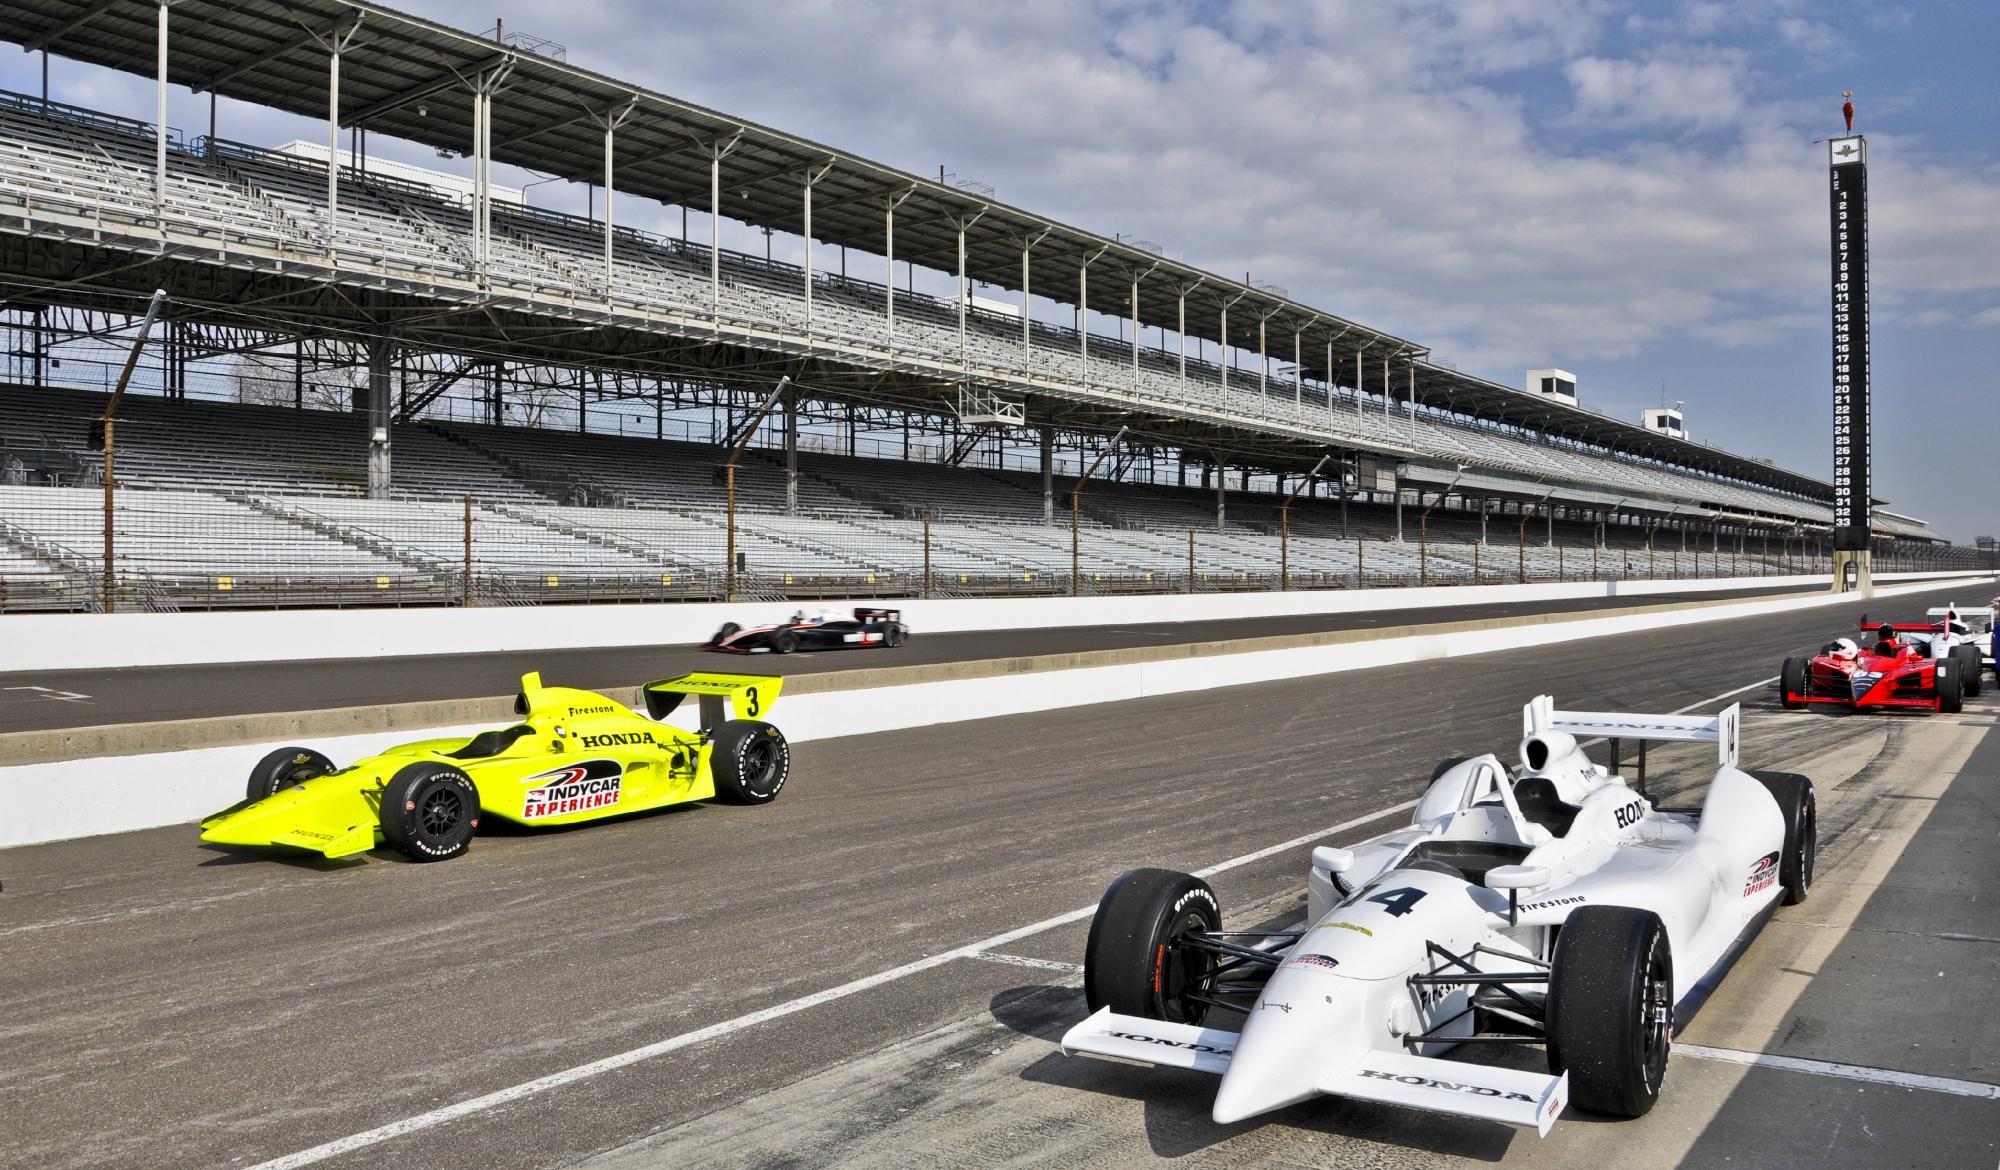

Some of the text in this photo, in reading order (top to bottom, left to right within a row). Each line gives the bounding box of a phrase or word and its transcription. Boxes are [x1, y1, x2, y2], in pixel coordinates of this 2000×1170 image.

[1840, 232, 1847, 240] 5
[1840, 242, 1847, 250] 6
[1841, 252, 1847, 260] 7
[1840, 262, 1848, 271] 8
[1841, 273, 1848, 281] 9
[1835, 283, 1848, 291] 10
[1836, 293, 1848, 302] 11
[1835, 304, 1848, 312] 12
[1835, 314, 1848, 322] 13
[1835, 324, 1849, 332] 14
[1836, 334, 1849, 342] 15
[1836, 344, 1849, 352] 16
[1836, 354, 1849, 362] 17
[1836, 365, 1849, 373] 18
[1836, 375, 1849, 383] 19
[1835, 385, 1849, 393] 20
[1835, 395, 1850, 404] 21
[1835, 405, 1850, 414] 22
[1835, 416, 1850, 424] 23
[1835, 426, 1850, 434] 24
[1836, 436, 1850, 444] 25
[1836, 447, 1850, 455] 26
[1836, 457, 1850, 465] 27
[1836, 467, 1850, 476] 28
[1835, 477, 1850, 485] 29
[1835, 488, 1850, 496] 30
[1836, 498, 1850, 506] 31
[1836, 508, 1850, 516] 32
[1835, 518, 1850, 527] 33
[746, 687, 759, 717] 3
[568, 705, 614, 717] Firestone
[581, 732, 656, 748] HONDA
[548, 777, 621, 801] INDYCAR
[524, 790, 619, 817] EXPERIENCE
[1517, 895, 1586, 913] Firestone
[1357, 1069, 1538, 1103] HONDA
